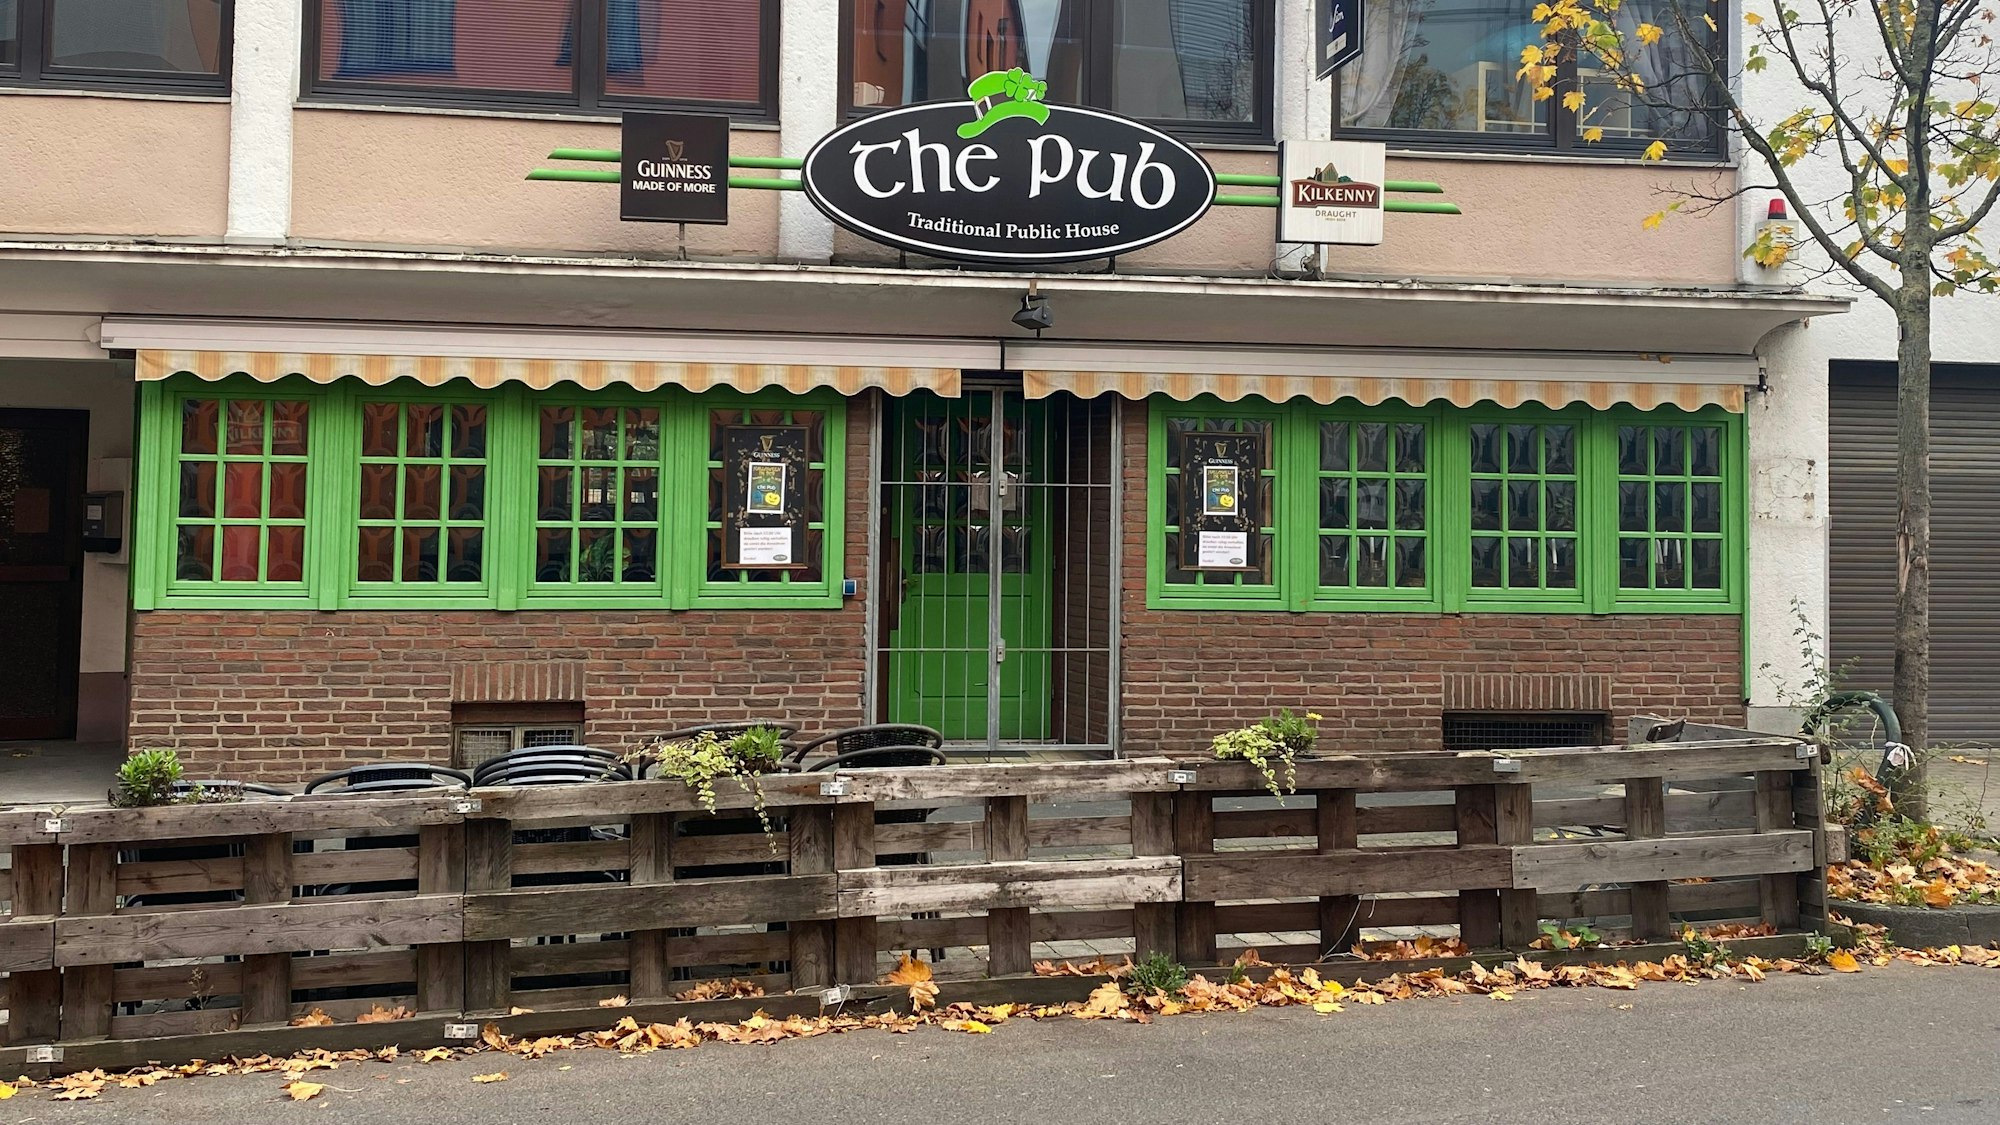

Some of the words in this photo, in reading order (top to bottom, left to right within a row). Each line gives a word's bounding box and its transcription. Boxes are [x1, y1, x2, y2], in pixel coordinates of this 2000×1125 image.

[637, 160, 712, 180] GUINNESS
[849, 128, 1000, 198] The
[1027, 134, 1176, 209] Pub
[632, 180, 665, 191] MADE
[667, 182, 682, 192] OF
[683, 183, 716, 193] MORE
[1298, 184, 1375, 203] KILKENNY
[1315, 210, 1357, 218] DRAUGHT
[907, 212, 1001, 238] Traditional
[1006, 223, 1061, 240] Public
[1066, 223, 1120, 238] House
